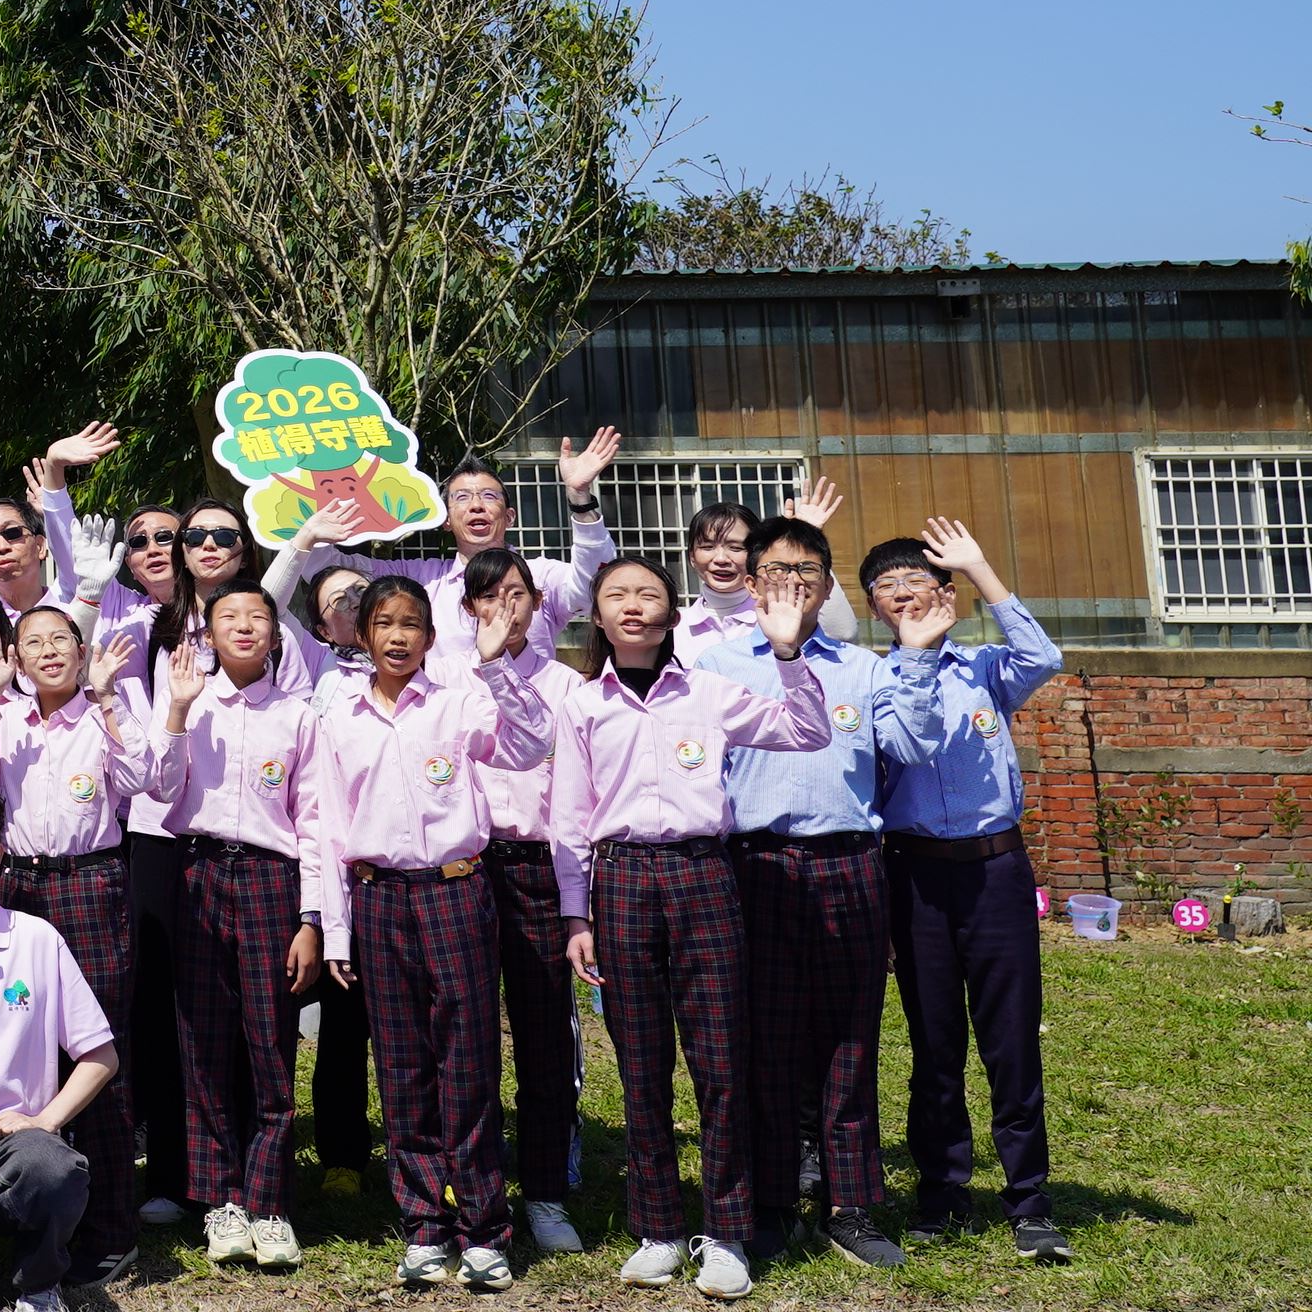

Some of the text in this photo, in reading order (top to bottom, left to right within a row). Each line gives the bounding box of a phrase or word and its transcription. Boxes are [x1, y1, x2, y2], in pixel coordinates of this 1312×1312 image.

[236, 382, 360, 422] 2026
[237, 415, 392, 463] 植得守護
[1178, 905, 1205, 926] 35
